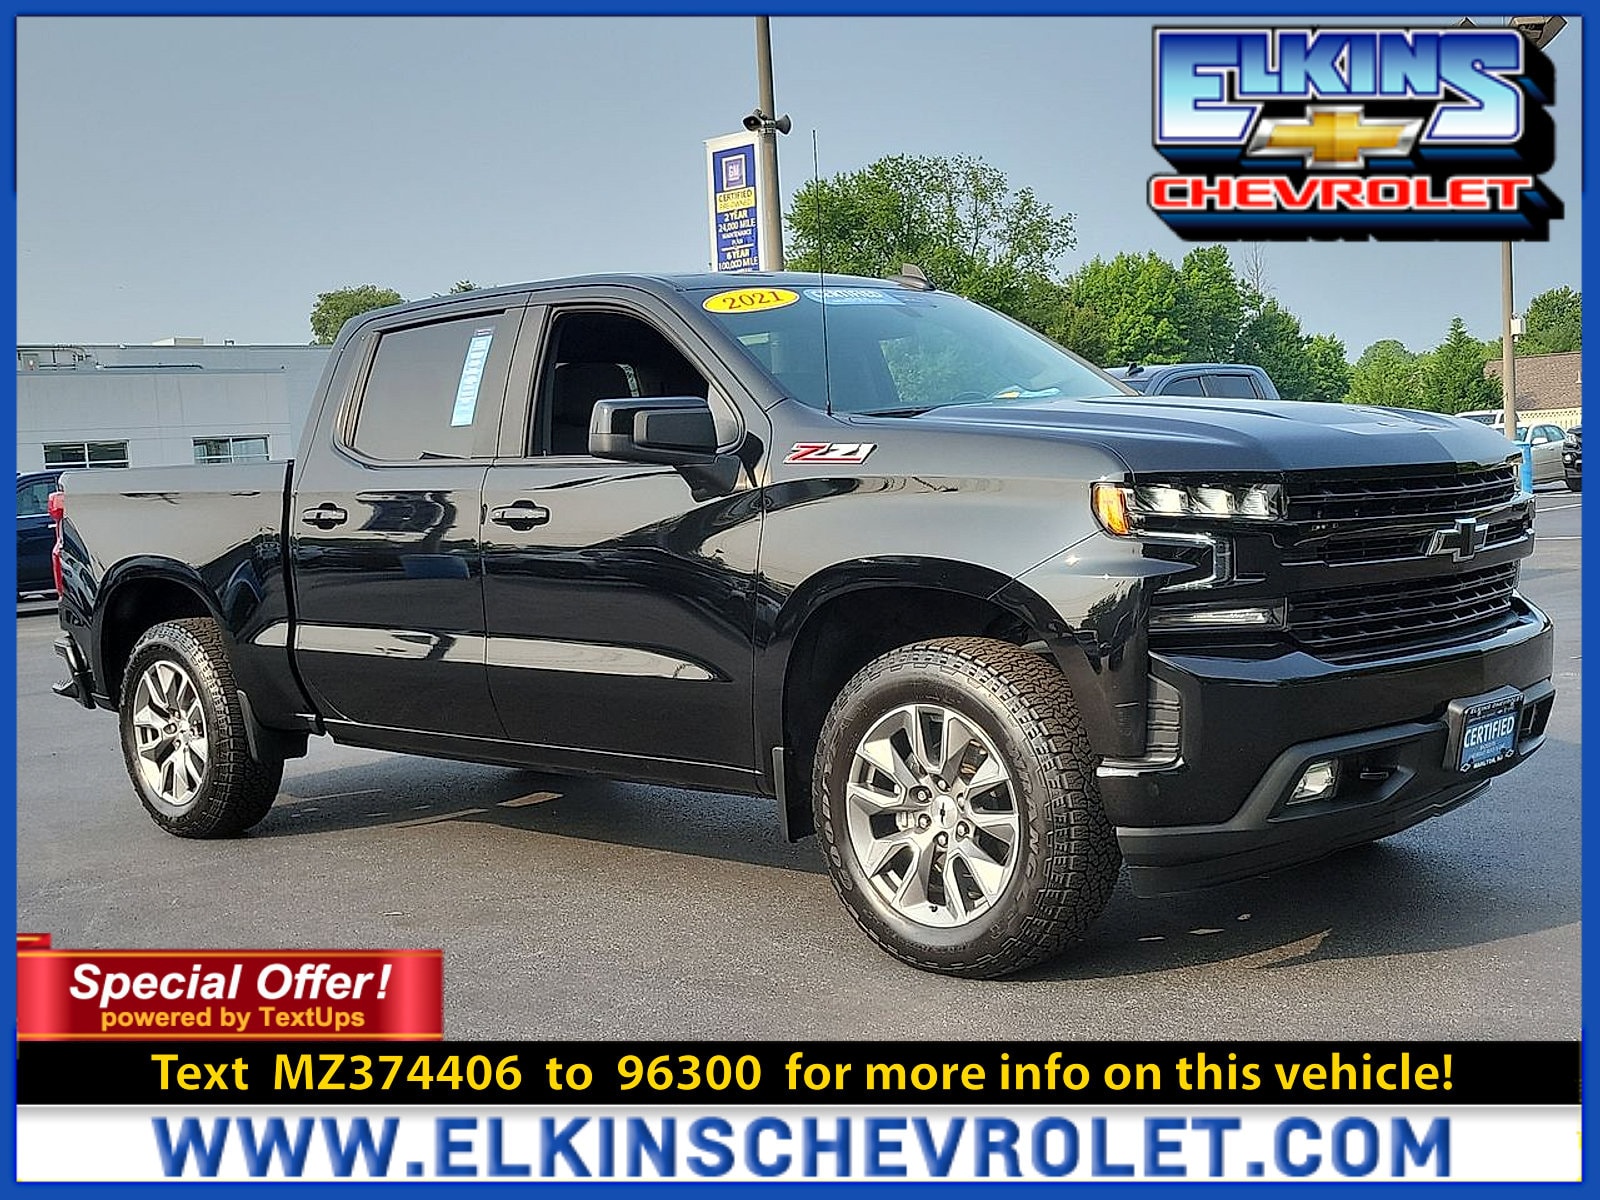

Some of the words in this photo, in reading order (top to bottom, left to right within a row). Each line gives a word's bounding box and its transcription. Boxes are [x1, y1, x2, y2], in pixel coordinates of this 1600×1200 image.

[718, 189, 753, 202] CERTIFIED
[723, 213, 730, 222] 2
[729, 209, 748, 221] YEAR
[732, 248, 750, 259] YEAR
[722, 290, 784, 310] 2021
[782, 442, 878, 464] Z71
[1463, 716, 1515, 748] CERTIFIED
